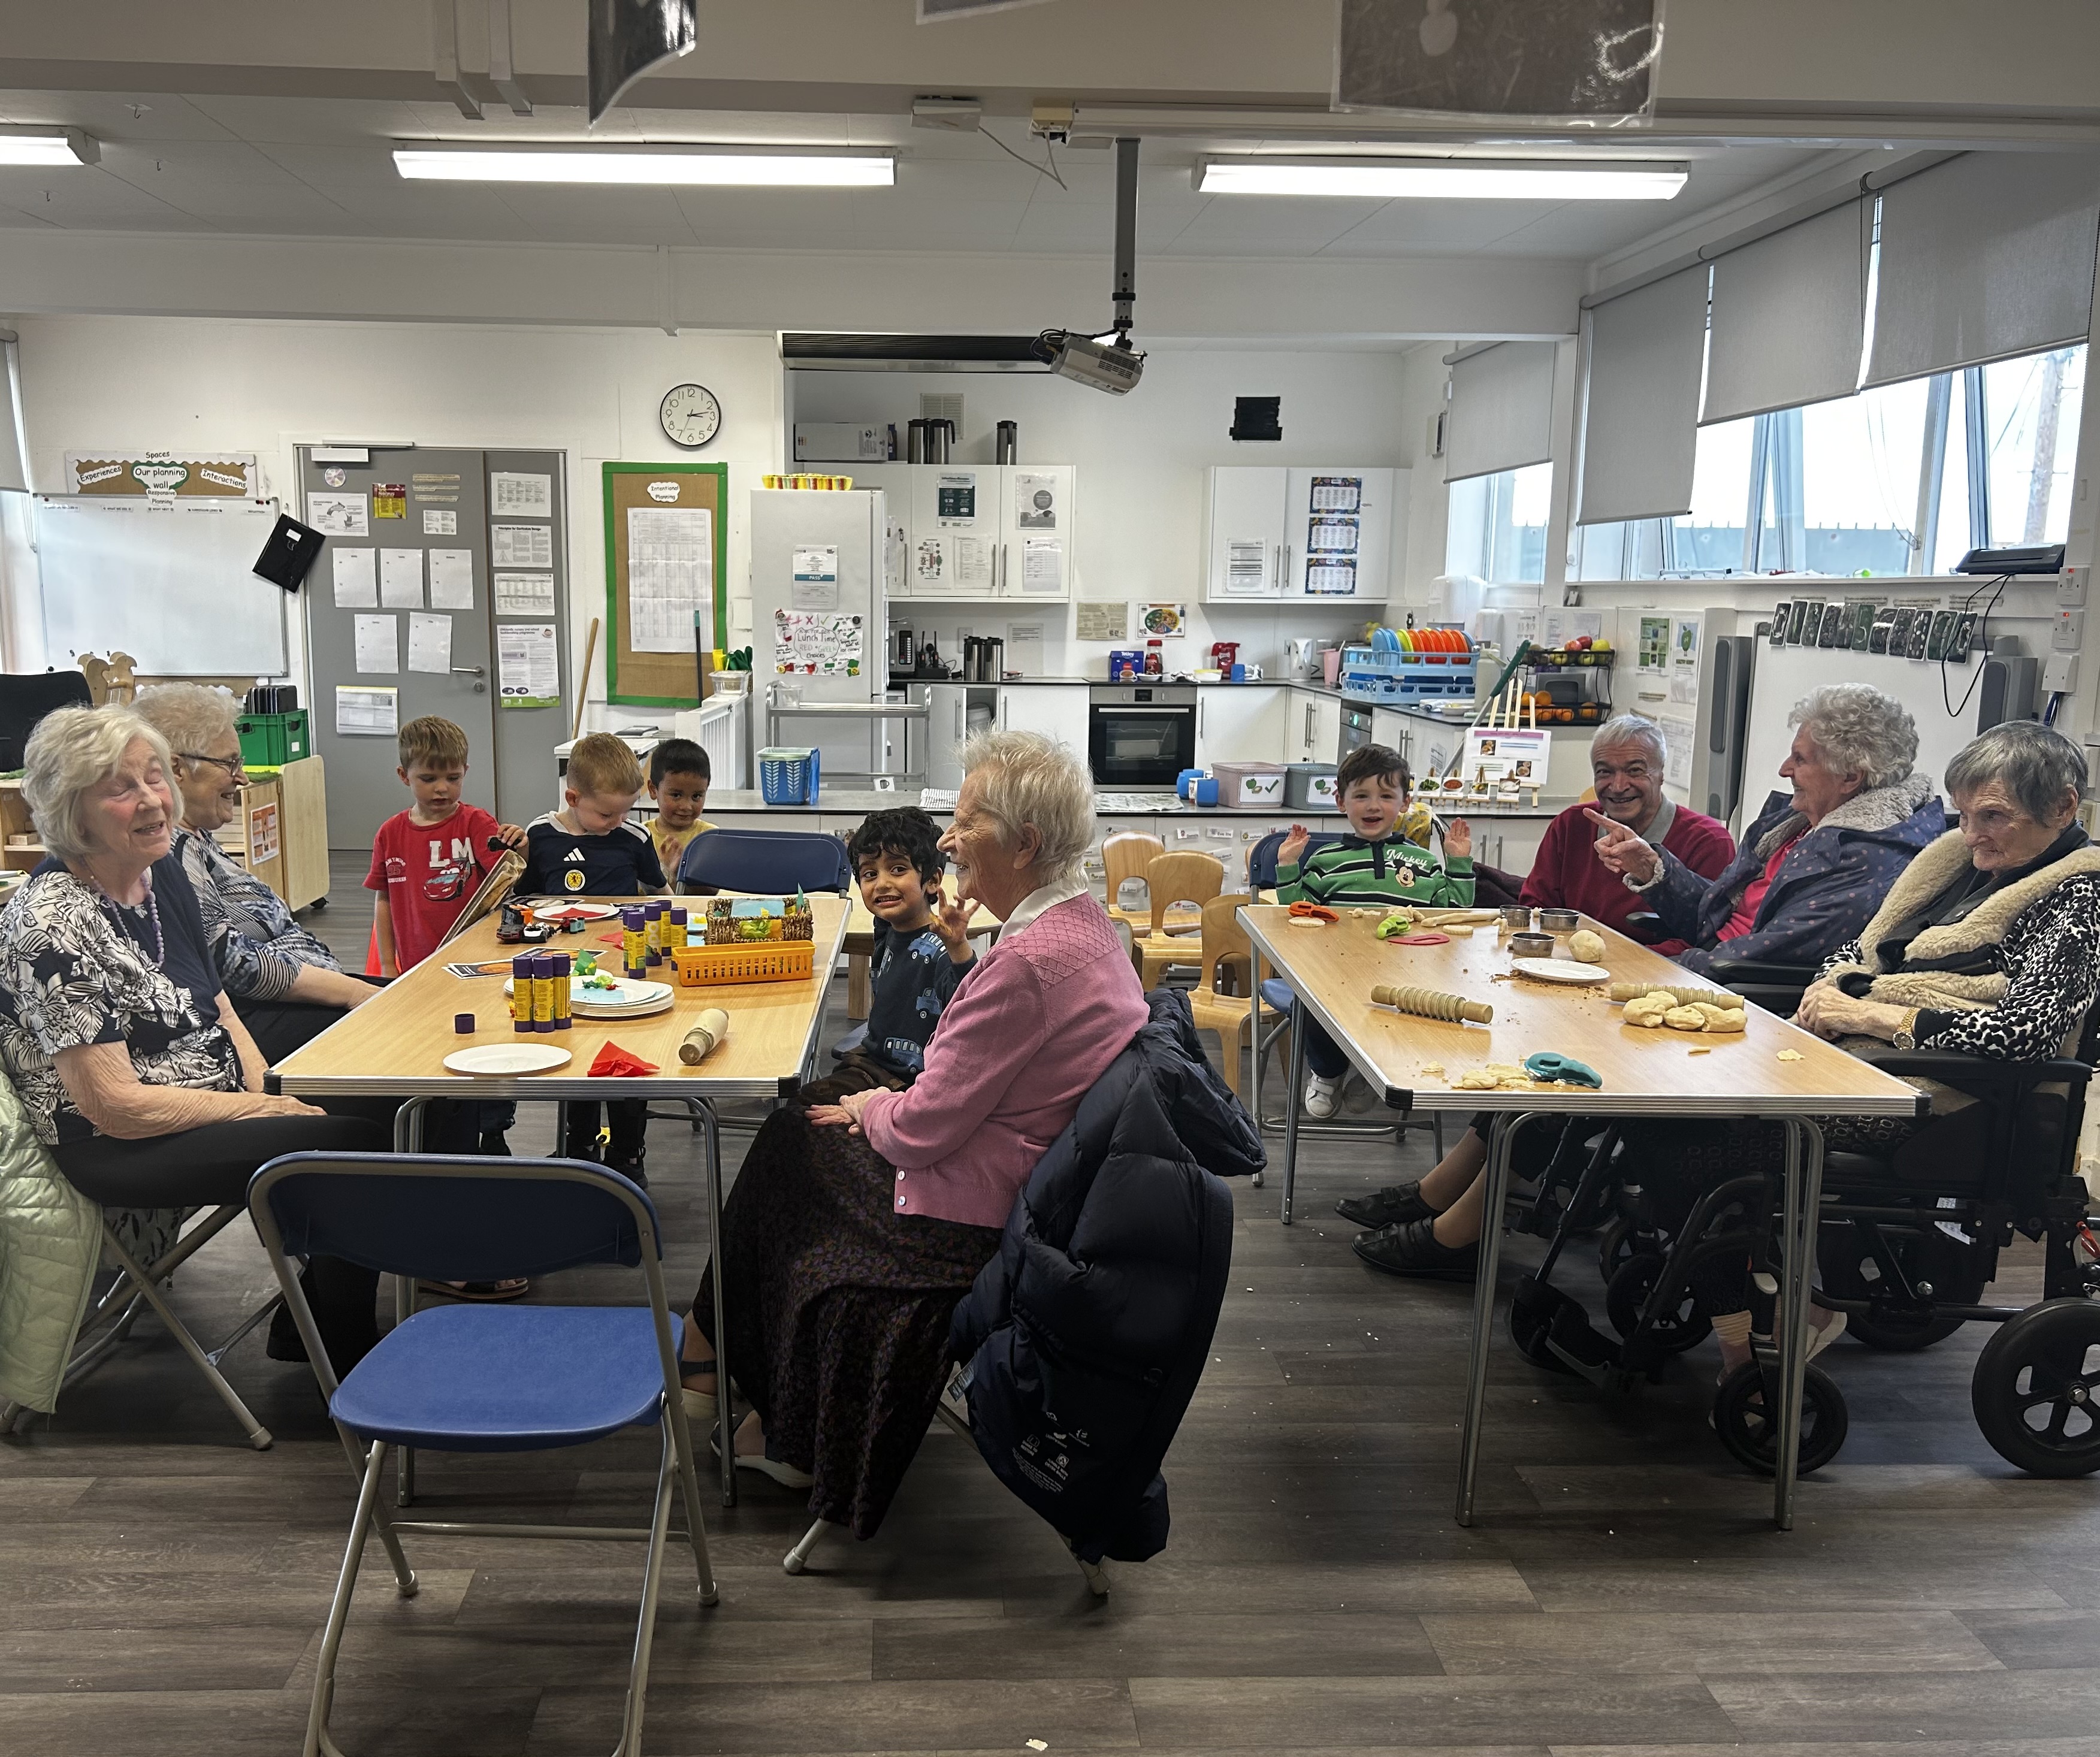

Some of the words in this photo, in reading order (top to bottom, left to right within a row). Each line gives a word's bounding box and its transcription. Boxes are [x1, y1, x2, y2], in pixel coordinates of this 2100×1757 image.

[678, 391, 684, 400] 11
[687, 388, 695, 398] 12
[701, 392, 703, 401] 1
[669, 399, 679, 407] 10
[706, 401, 713, 410] 2
[666, 409, 672, 418] 9
[709, 412, 716, 421] 3
[669, 421, 675, 430] 8
[676, 430, 683, 439] 7
[687, 433, 694, 442] 6
[699, 431, 705, 440] 5
[80, 466, 122, 482] Experiences
[153, 468, 185, 477] planning
[202, 470, 247, 489] Interactions
[797, 633, 818, 642] Lunch
[818, 632, 836, 643] Time
[1386, 849, 1428, 868] Mickey
